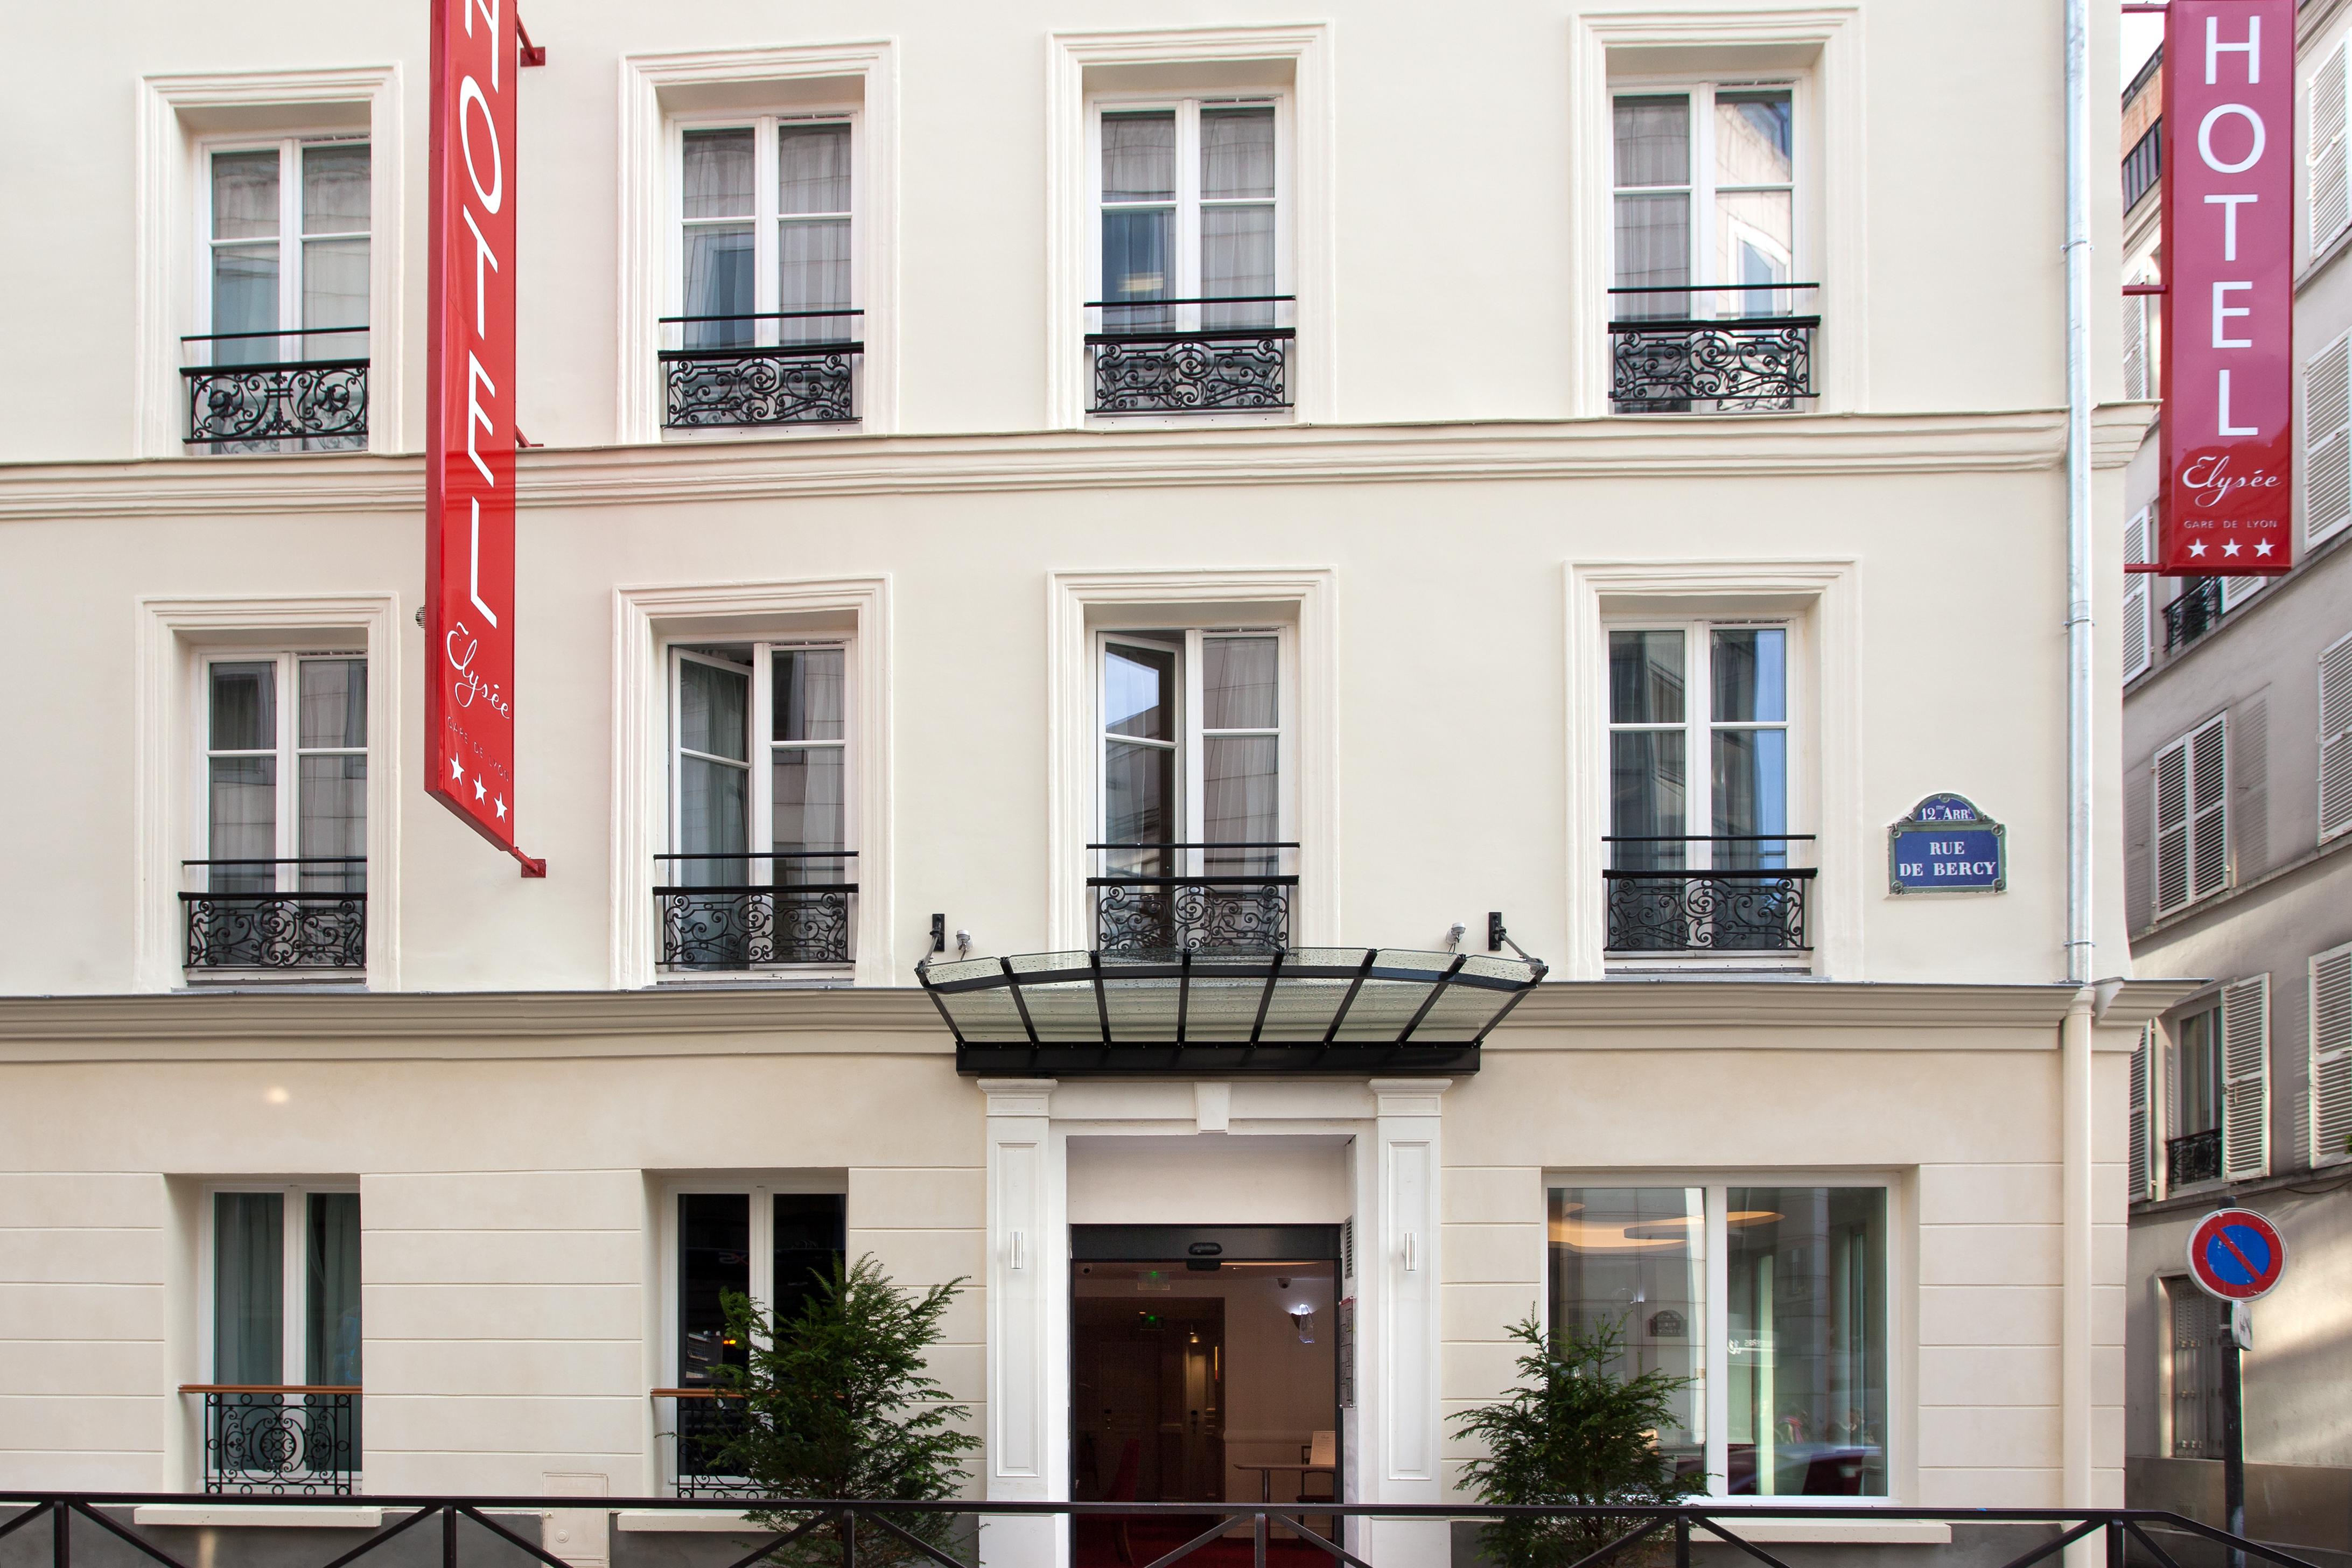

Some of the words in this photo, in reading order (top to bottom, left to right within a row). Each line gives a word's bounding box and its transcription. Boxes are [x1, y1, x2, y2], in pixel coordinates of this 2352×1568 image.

[2197, 16, 2266, 437] HOTEL
[2183, 520, 2214, 529] GARE
[2223, 520, 2238, 529] DE
[2246, 520, 2278, 528] LYON
[474, 741, 484, 759] DE
[1929, 841, 1965, 855] RUE
[1899, 863, 1923, 877] DE
[1933, 862, 1997, 876] BERCY
